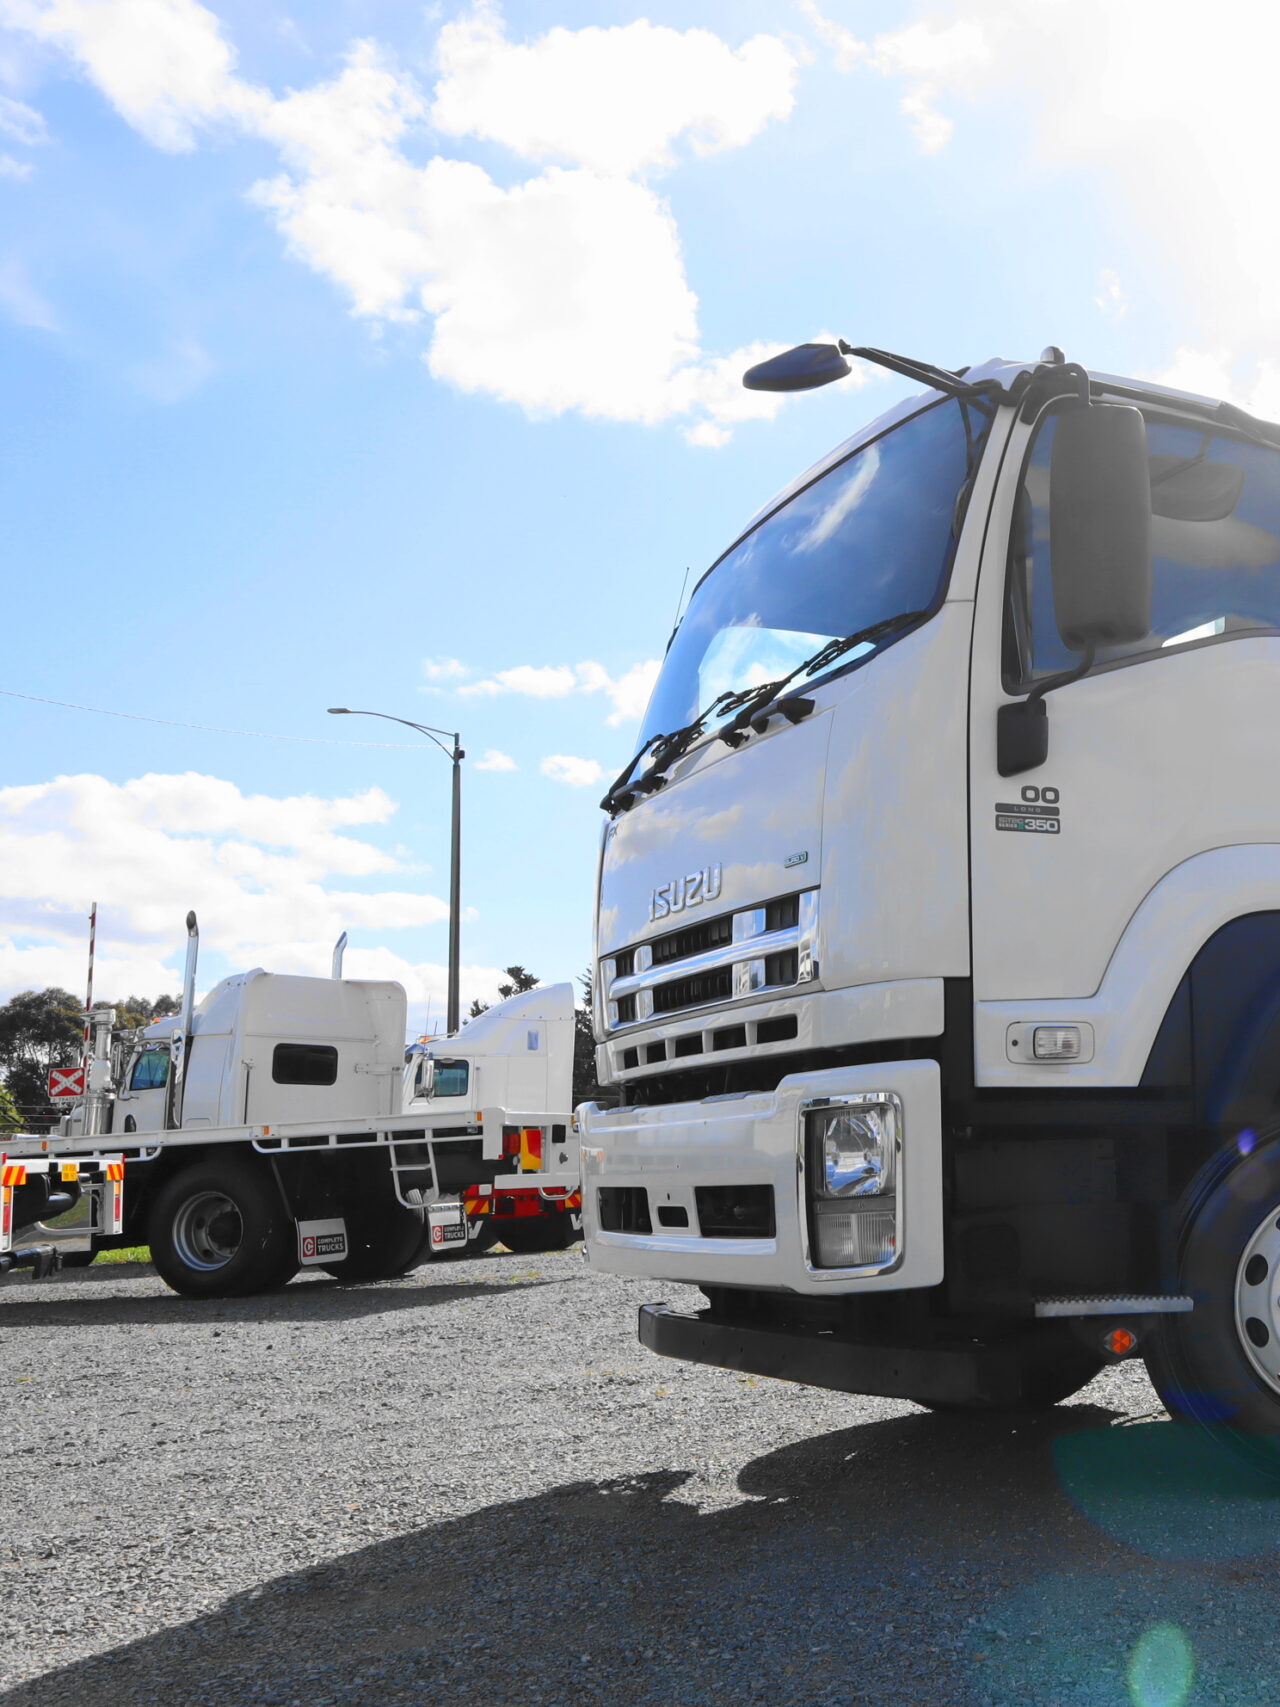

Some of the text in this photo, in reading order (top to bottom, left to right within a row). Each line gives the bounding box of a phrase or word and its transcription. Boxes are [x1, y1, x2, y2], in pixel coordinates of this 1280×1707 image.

[1024, 818, 1059, 831] 350
[650, 862, 721, 922] ISUZU
[444, 1231, 465, 1239] TRUCKS
[317, 1243, 344, 1252] TRUCKS
